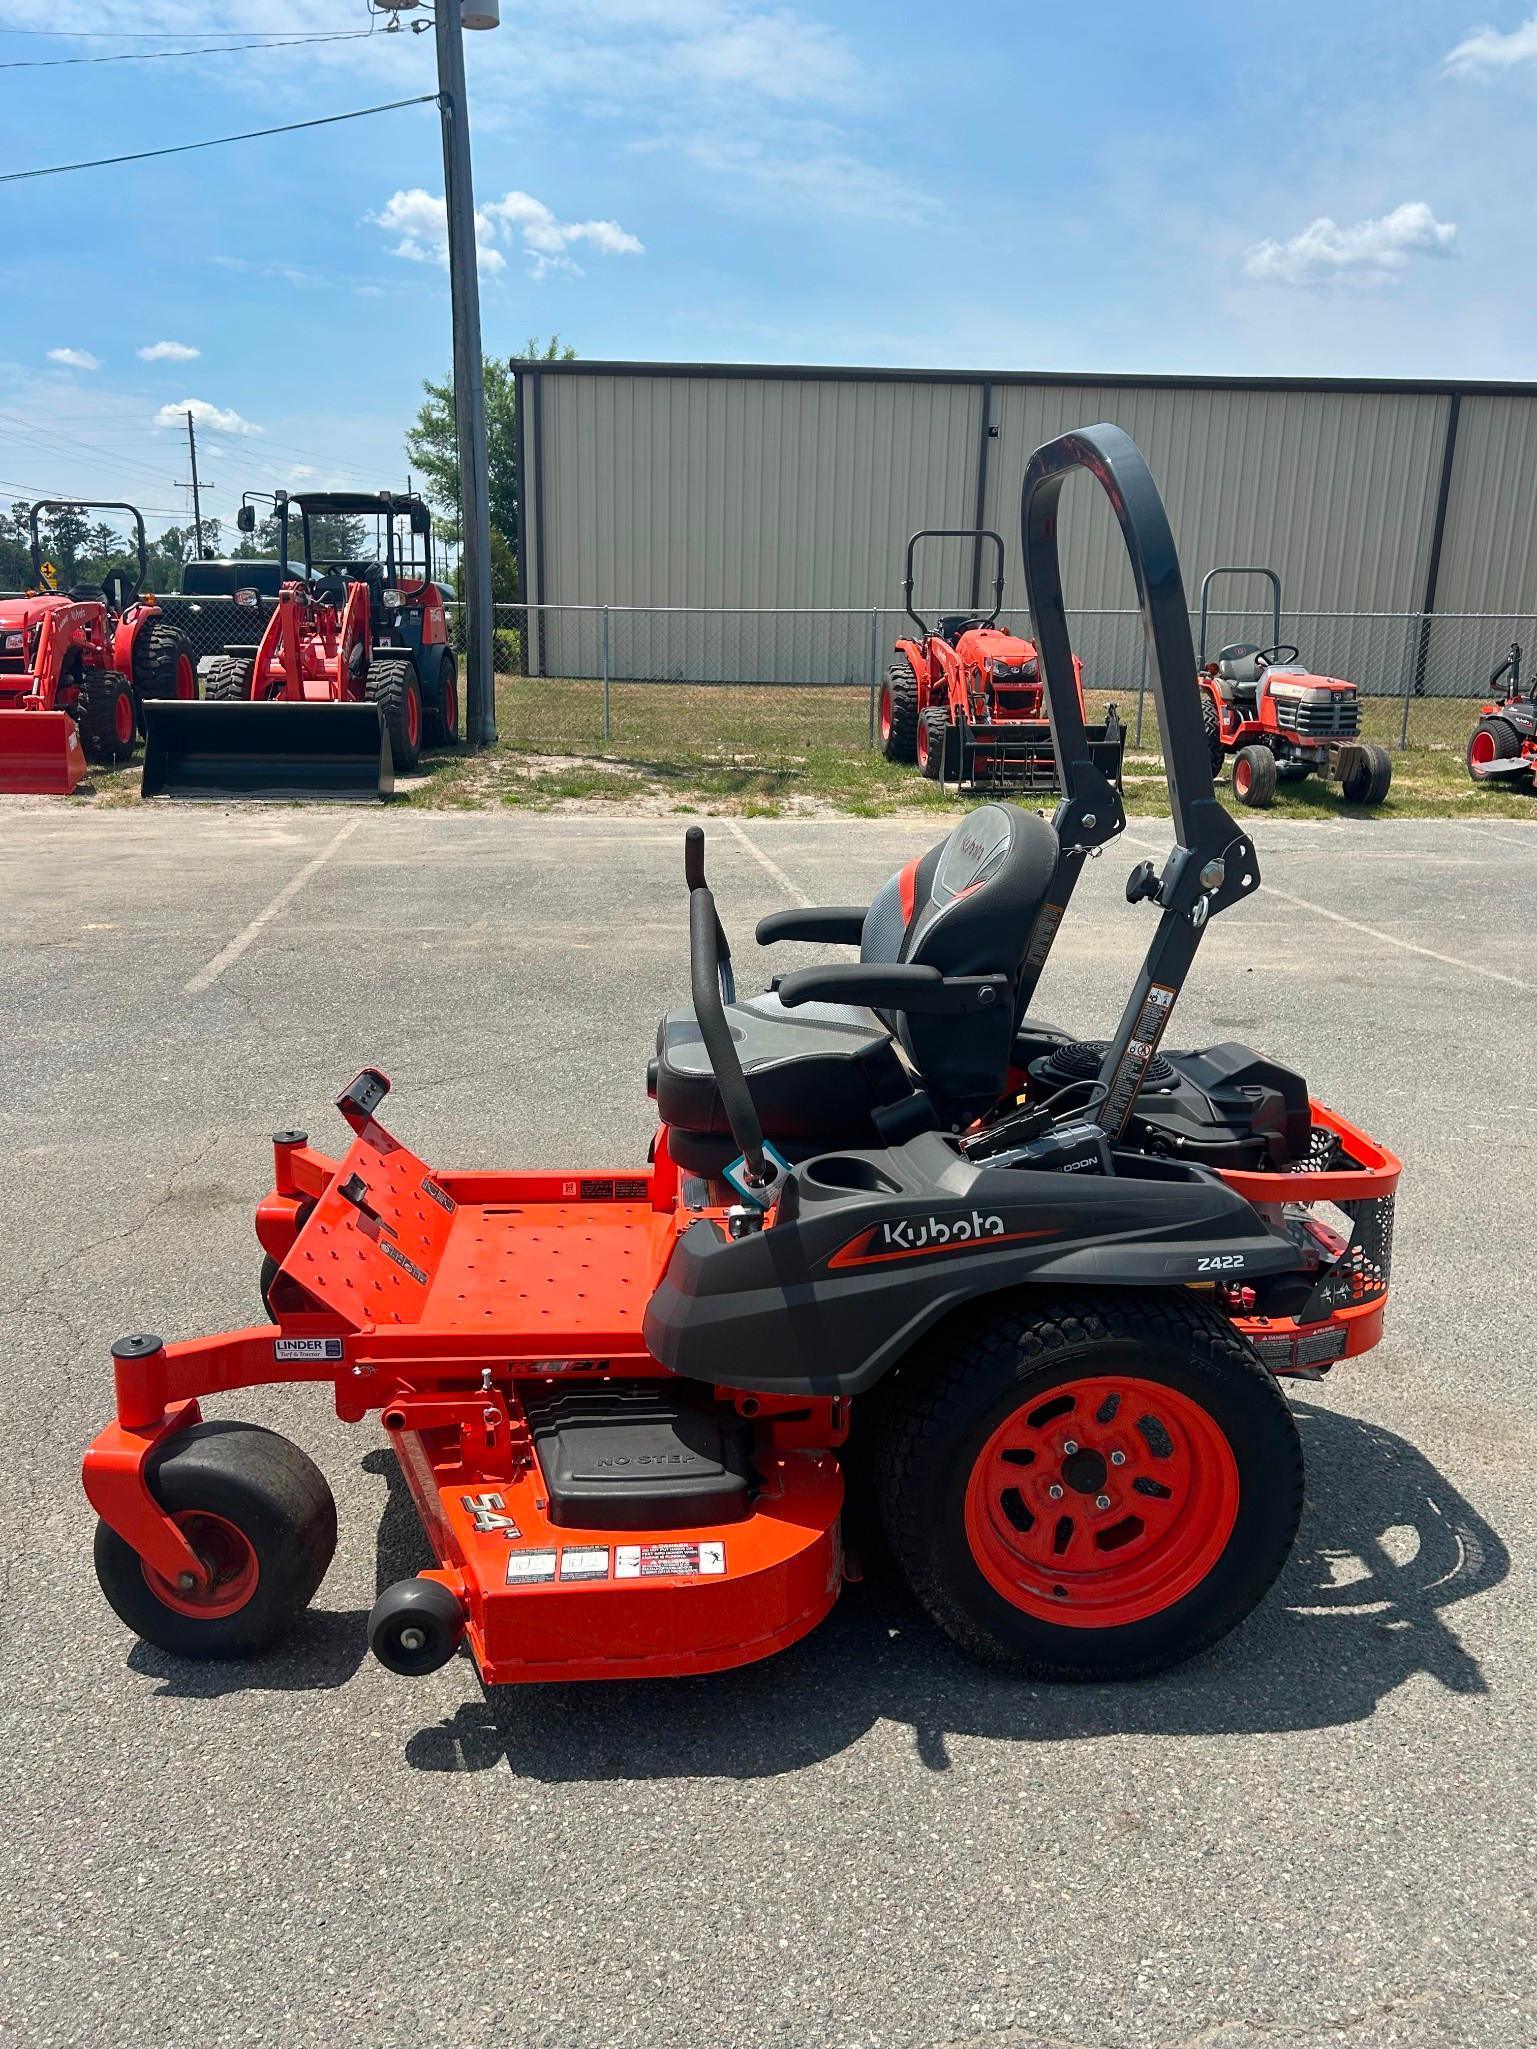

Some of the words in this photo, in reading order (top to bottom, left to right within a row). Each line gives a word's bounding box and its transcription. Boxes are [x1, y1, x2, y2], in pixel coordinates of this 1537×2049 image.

[1063, 1156, 1098, 1172] NOCO
[883, 1211, 1004, 1247] Kubota
[1197, 1255, 1245, 1271] Z422
[276, 1340, 323, 1350] LINDER
[511, 1361, 607, 1373] K-LIFT
[597, 1457, 631, 1467] NO
[638, 1455, 696, 1465] STEP
